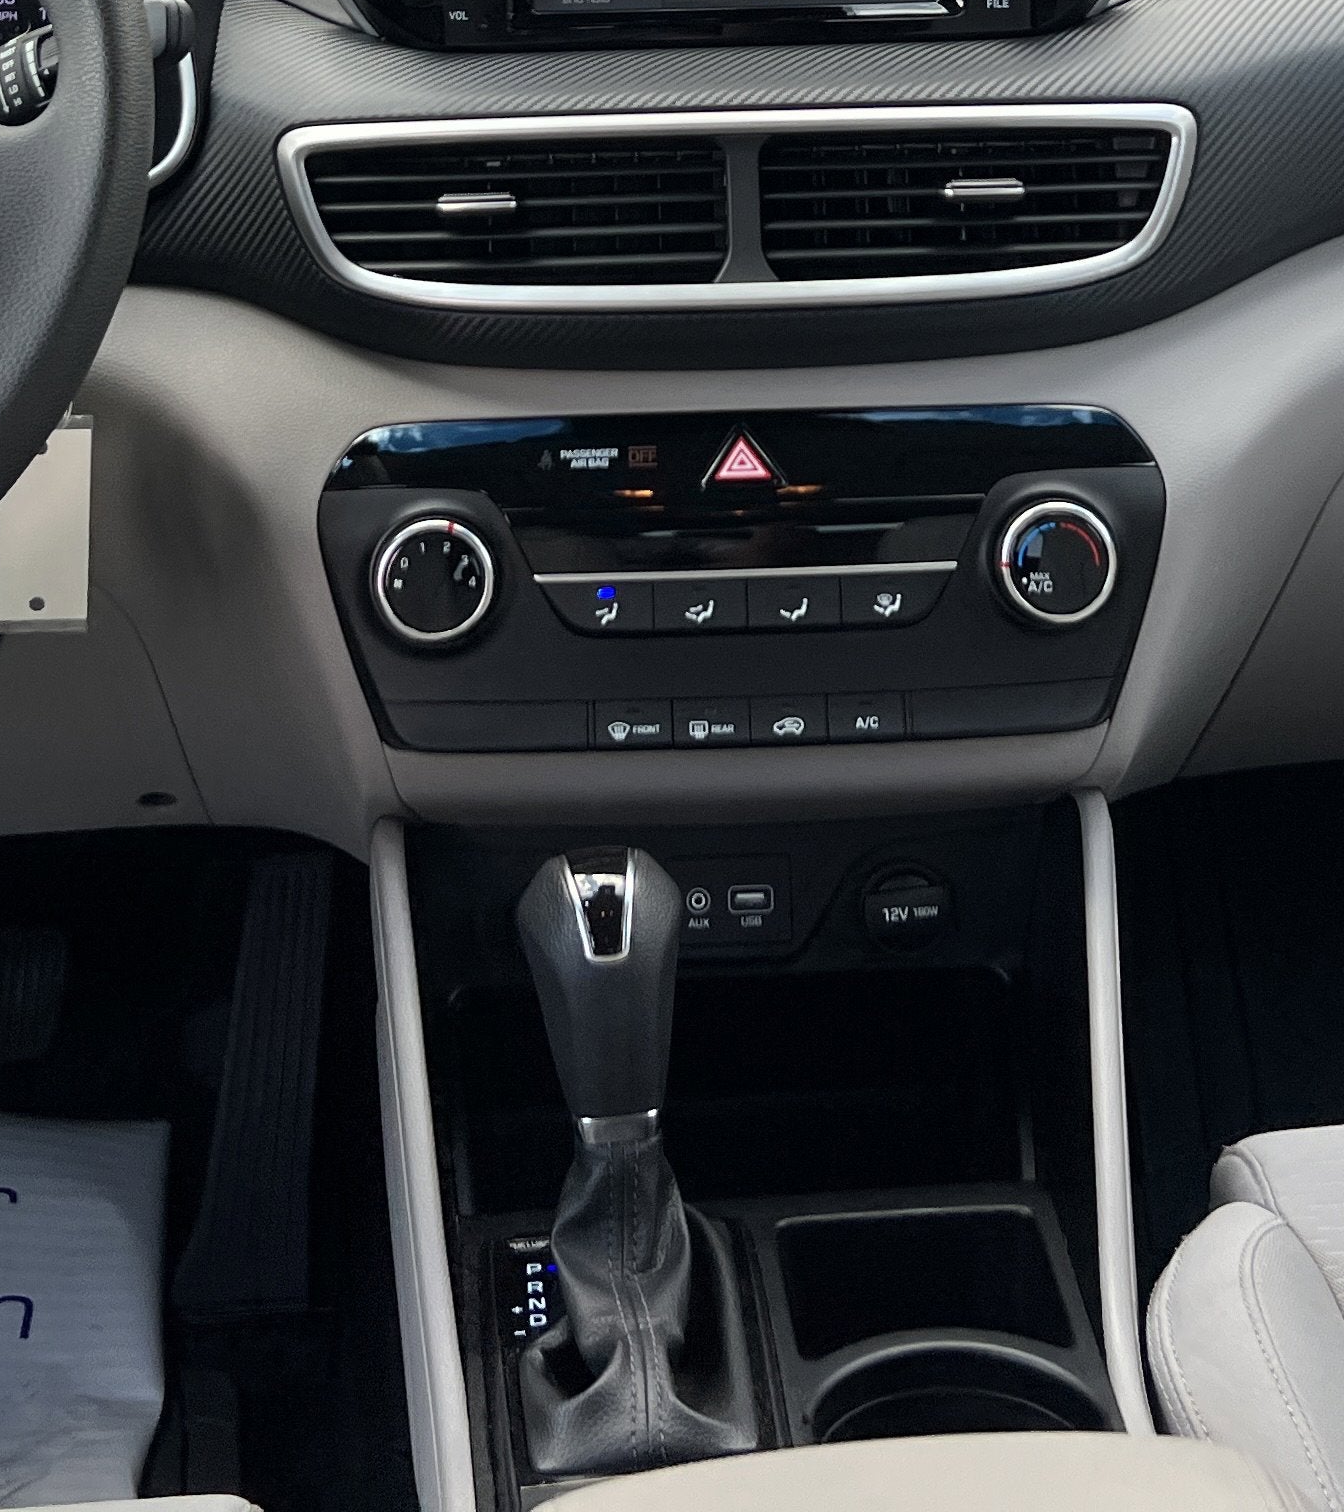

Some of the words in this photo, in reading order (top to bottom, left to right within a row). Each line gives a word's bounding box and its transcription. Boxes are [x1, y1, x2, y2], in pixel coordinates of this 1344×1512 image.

[986, 0, 1010, 8] FILE
[449, 11, 468, 21] VOL
[560, 448, 619, 459] PASSENGER
[420, 542, 425, 553] 1
[443, 541, 451, 553] 2
[468, 576, 476, 587] 4
[1030, 572, 1050, 580] MAX
[1028, 580, 1053, 594] A/C
[856, 716, 879, 729] A/C
[632, 723, 660, 734] FRONT
[711, 724, 734, 734] REAR
[882, 906, 908, 923] 12V
[688, 917, 710, 928] AUX
[526, 1263, 542, 1275] P
[527, 1281, 543, 1294] R
[528, 1296, 546, 1310] N
[529, 1314, 547, 1327] D
